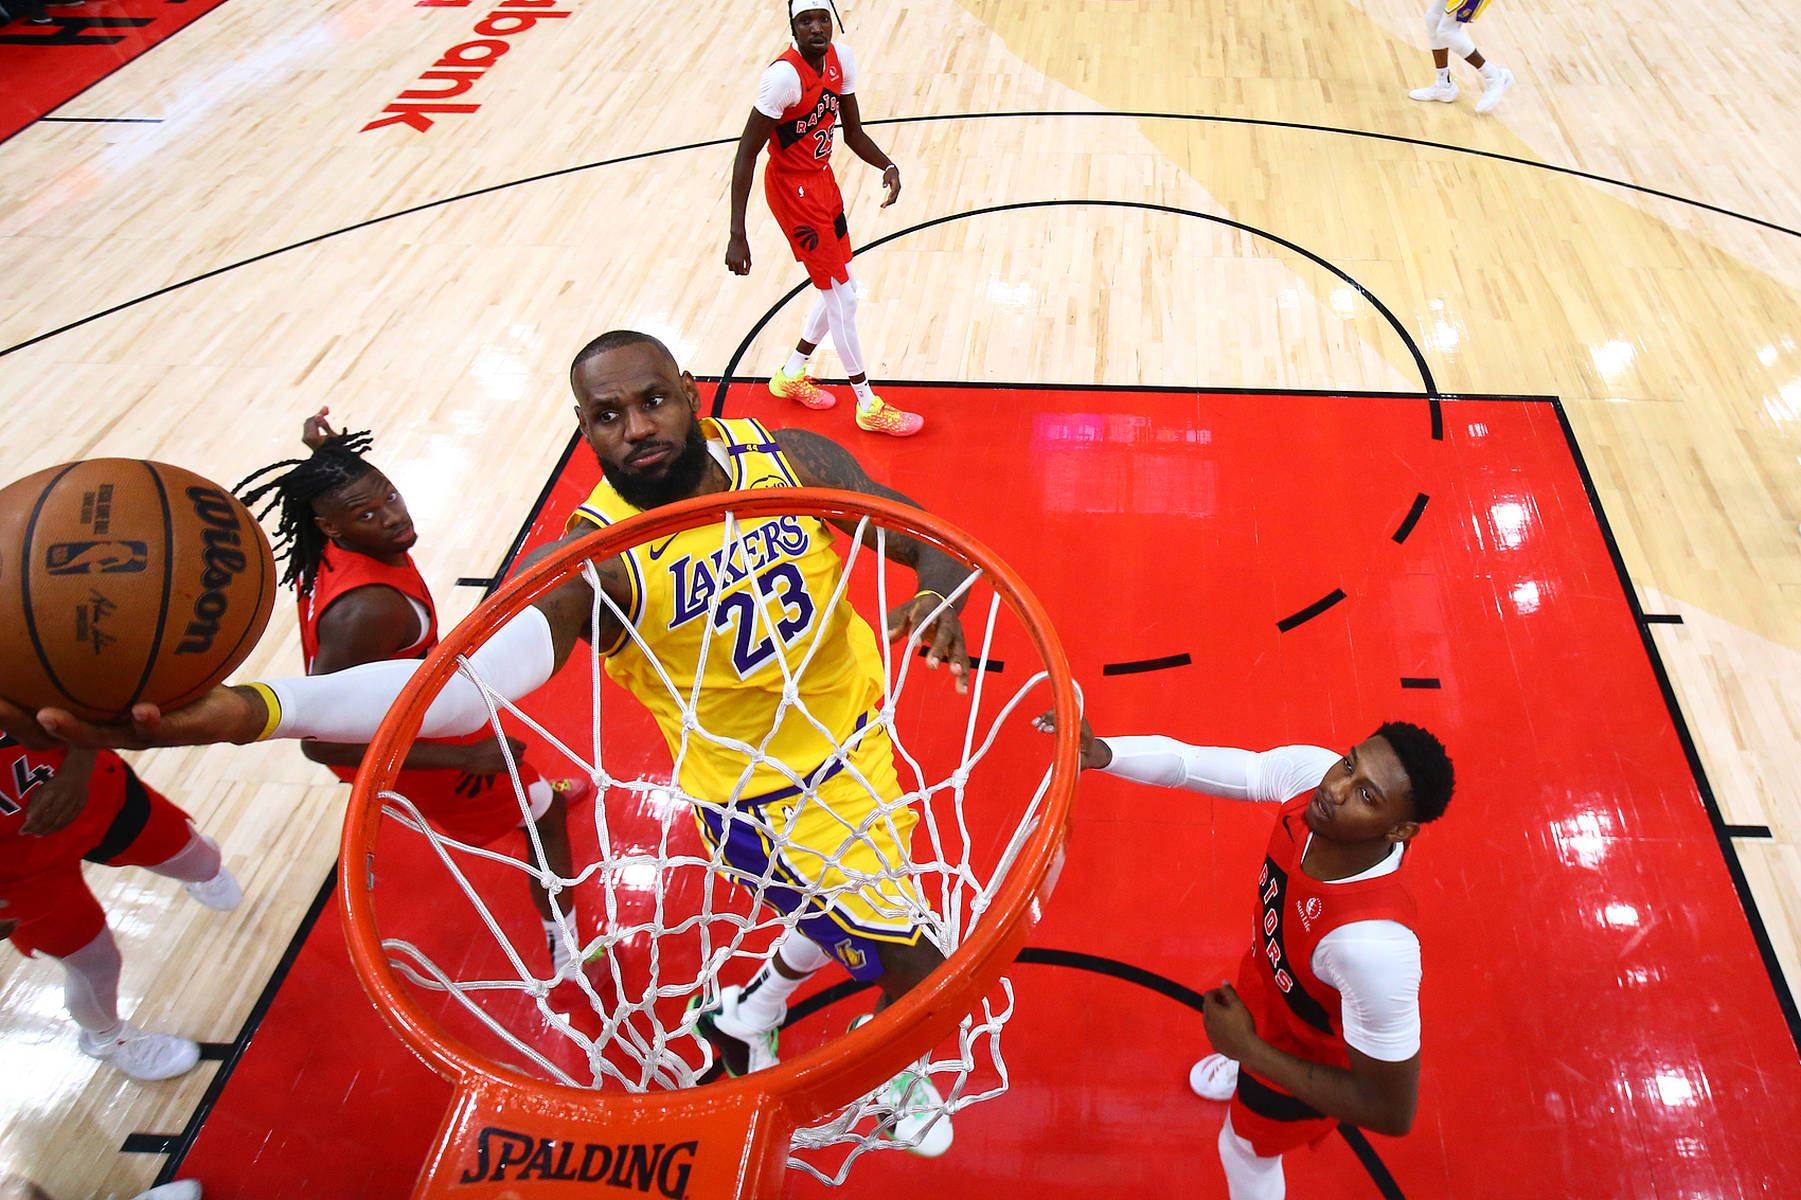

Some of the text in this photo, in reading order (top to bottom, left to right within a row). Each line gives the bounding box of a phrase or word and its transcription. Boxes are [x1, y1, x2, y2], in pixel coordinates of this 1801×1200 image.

[359, 0, 572, 134] bank
[174, 486, 247, 655] Wilson
[667, 516, 810, 631] LAKERS
[714, 562, 818, 681] 23
[460, 1126, 699, 1199] SPALDING
